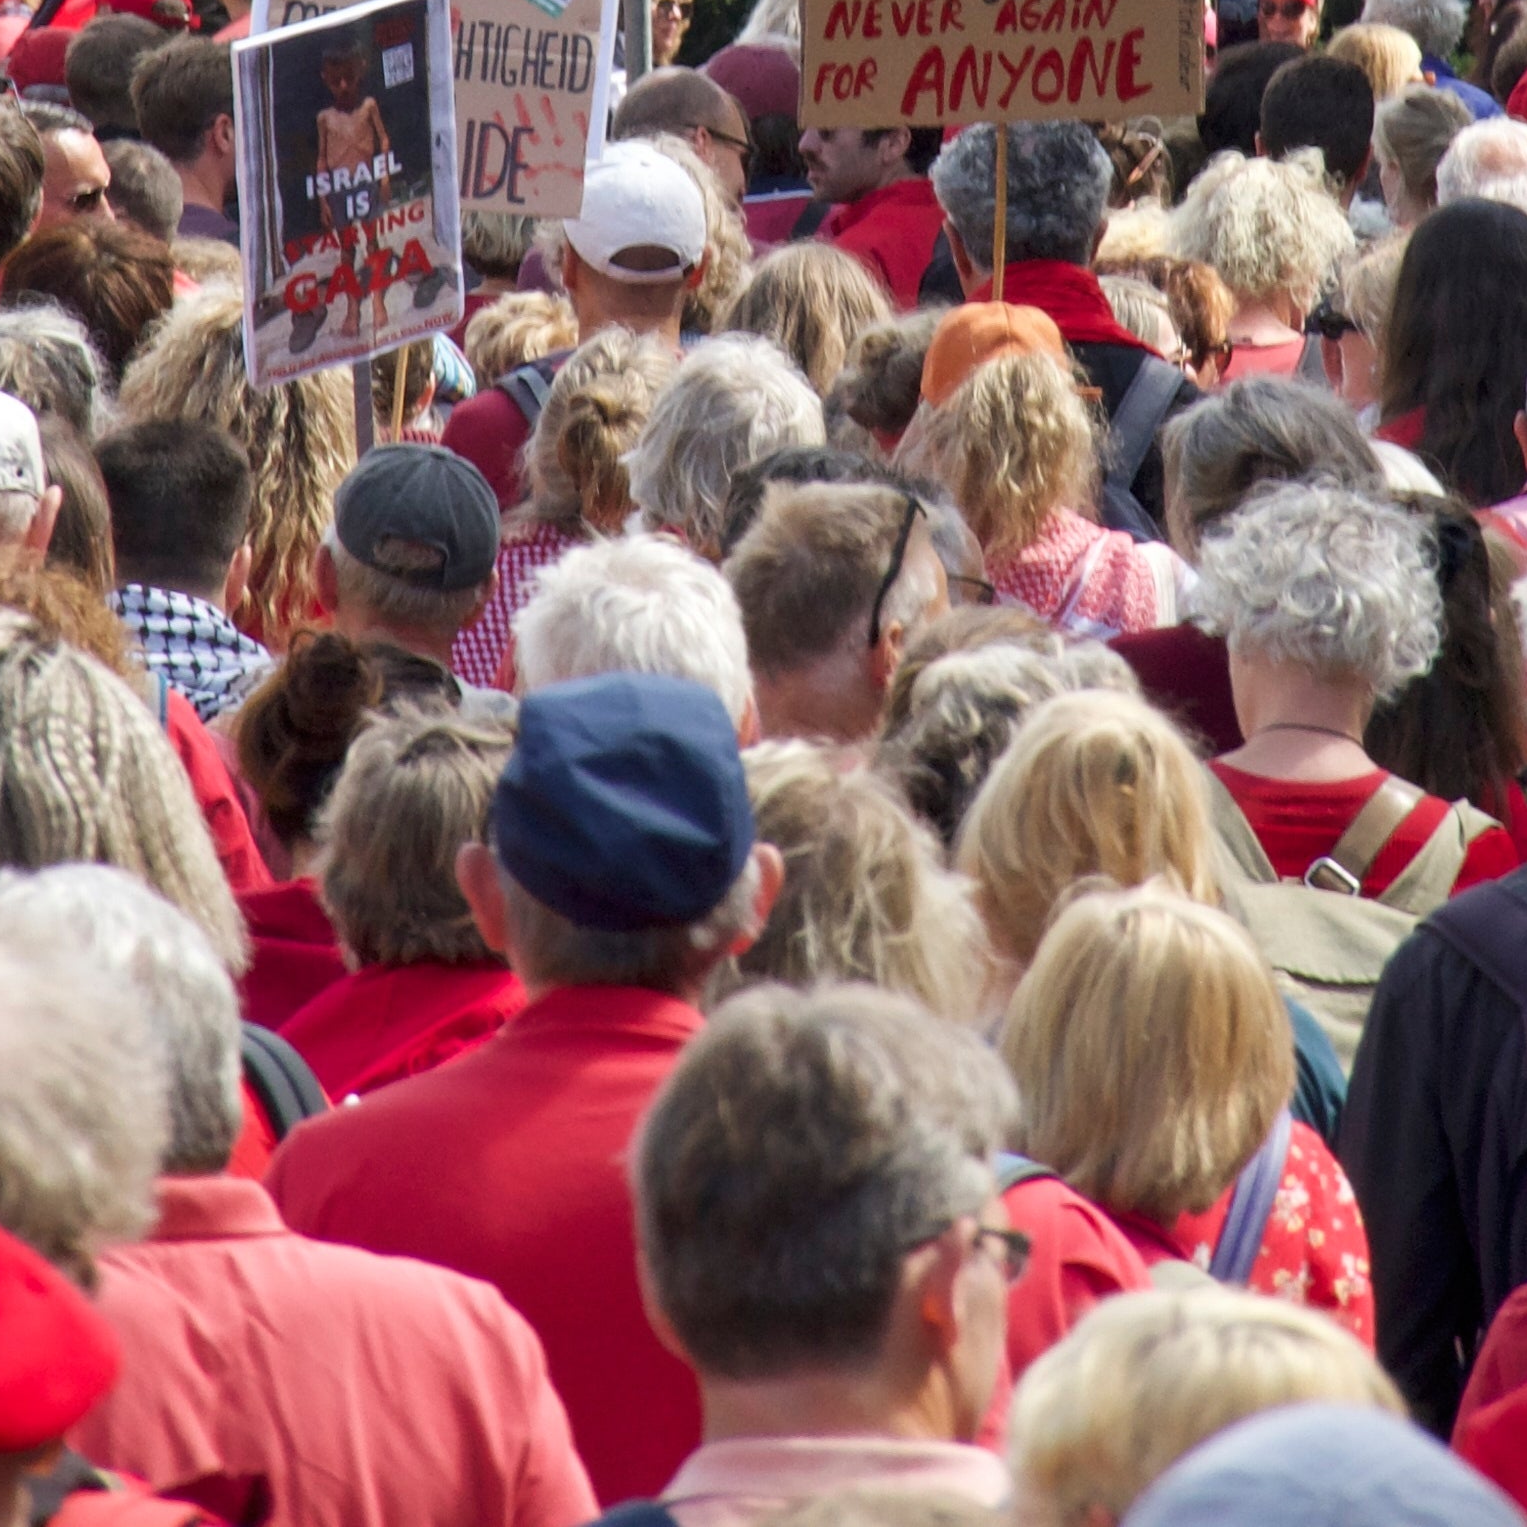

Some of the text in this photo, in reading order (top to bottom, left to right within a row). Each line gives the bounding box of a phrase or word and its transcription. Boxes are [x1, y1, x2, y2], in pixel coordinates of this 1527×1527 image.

[814, 58, 878, 104] FOR
[900, 26, 1153, 117] ANYONE
[305, 150, 403, 201] ISRAEL
[346, 190, 371, 220] IS
[284, 200, 425, 266] STARVING
[283, 238, 434, 313] GAZA
